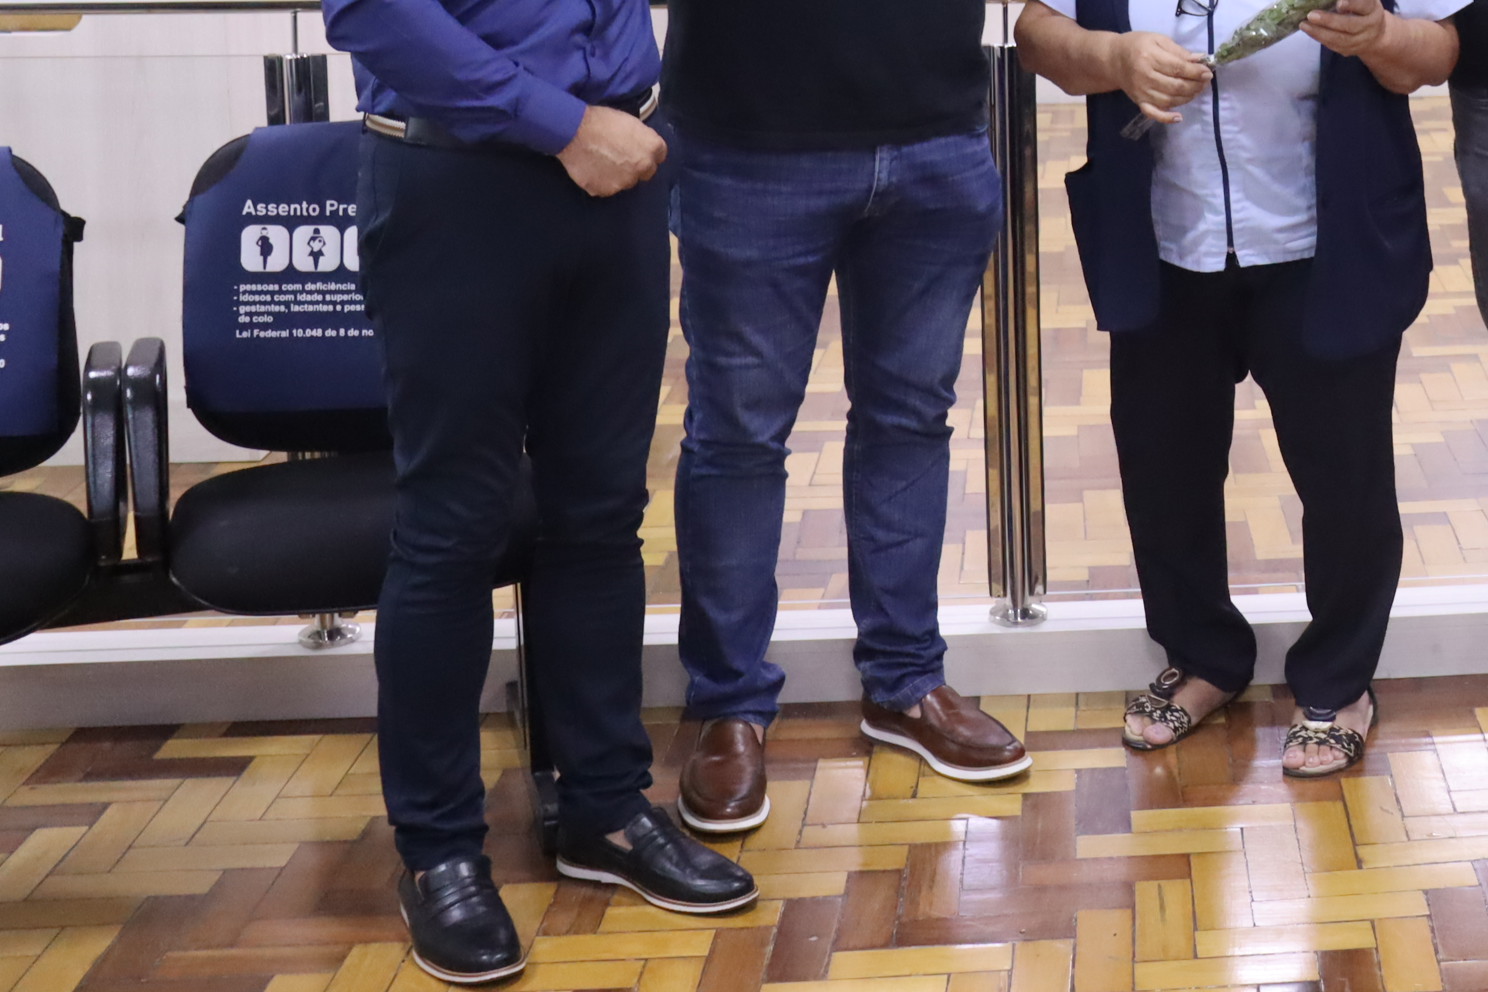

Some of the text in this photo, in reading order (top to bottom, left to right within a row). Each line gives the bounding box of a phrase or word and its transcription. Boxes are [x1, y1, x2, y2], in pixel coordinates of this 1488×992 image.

[242, 199, 319, 216] Assento
[240, 284, 279, 292] pessoas
[305, 282, 355, 291] deficiência
[239, 304, 288, 314] gestantes,
[238, 315, 250, 323] de
[236, 329, 251, 338] Lei
[254, 329, 289, 337] Federal
[292, 329, 322, 337] 10.048
[348, 328, 359, 336] de
